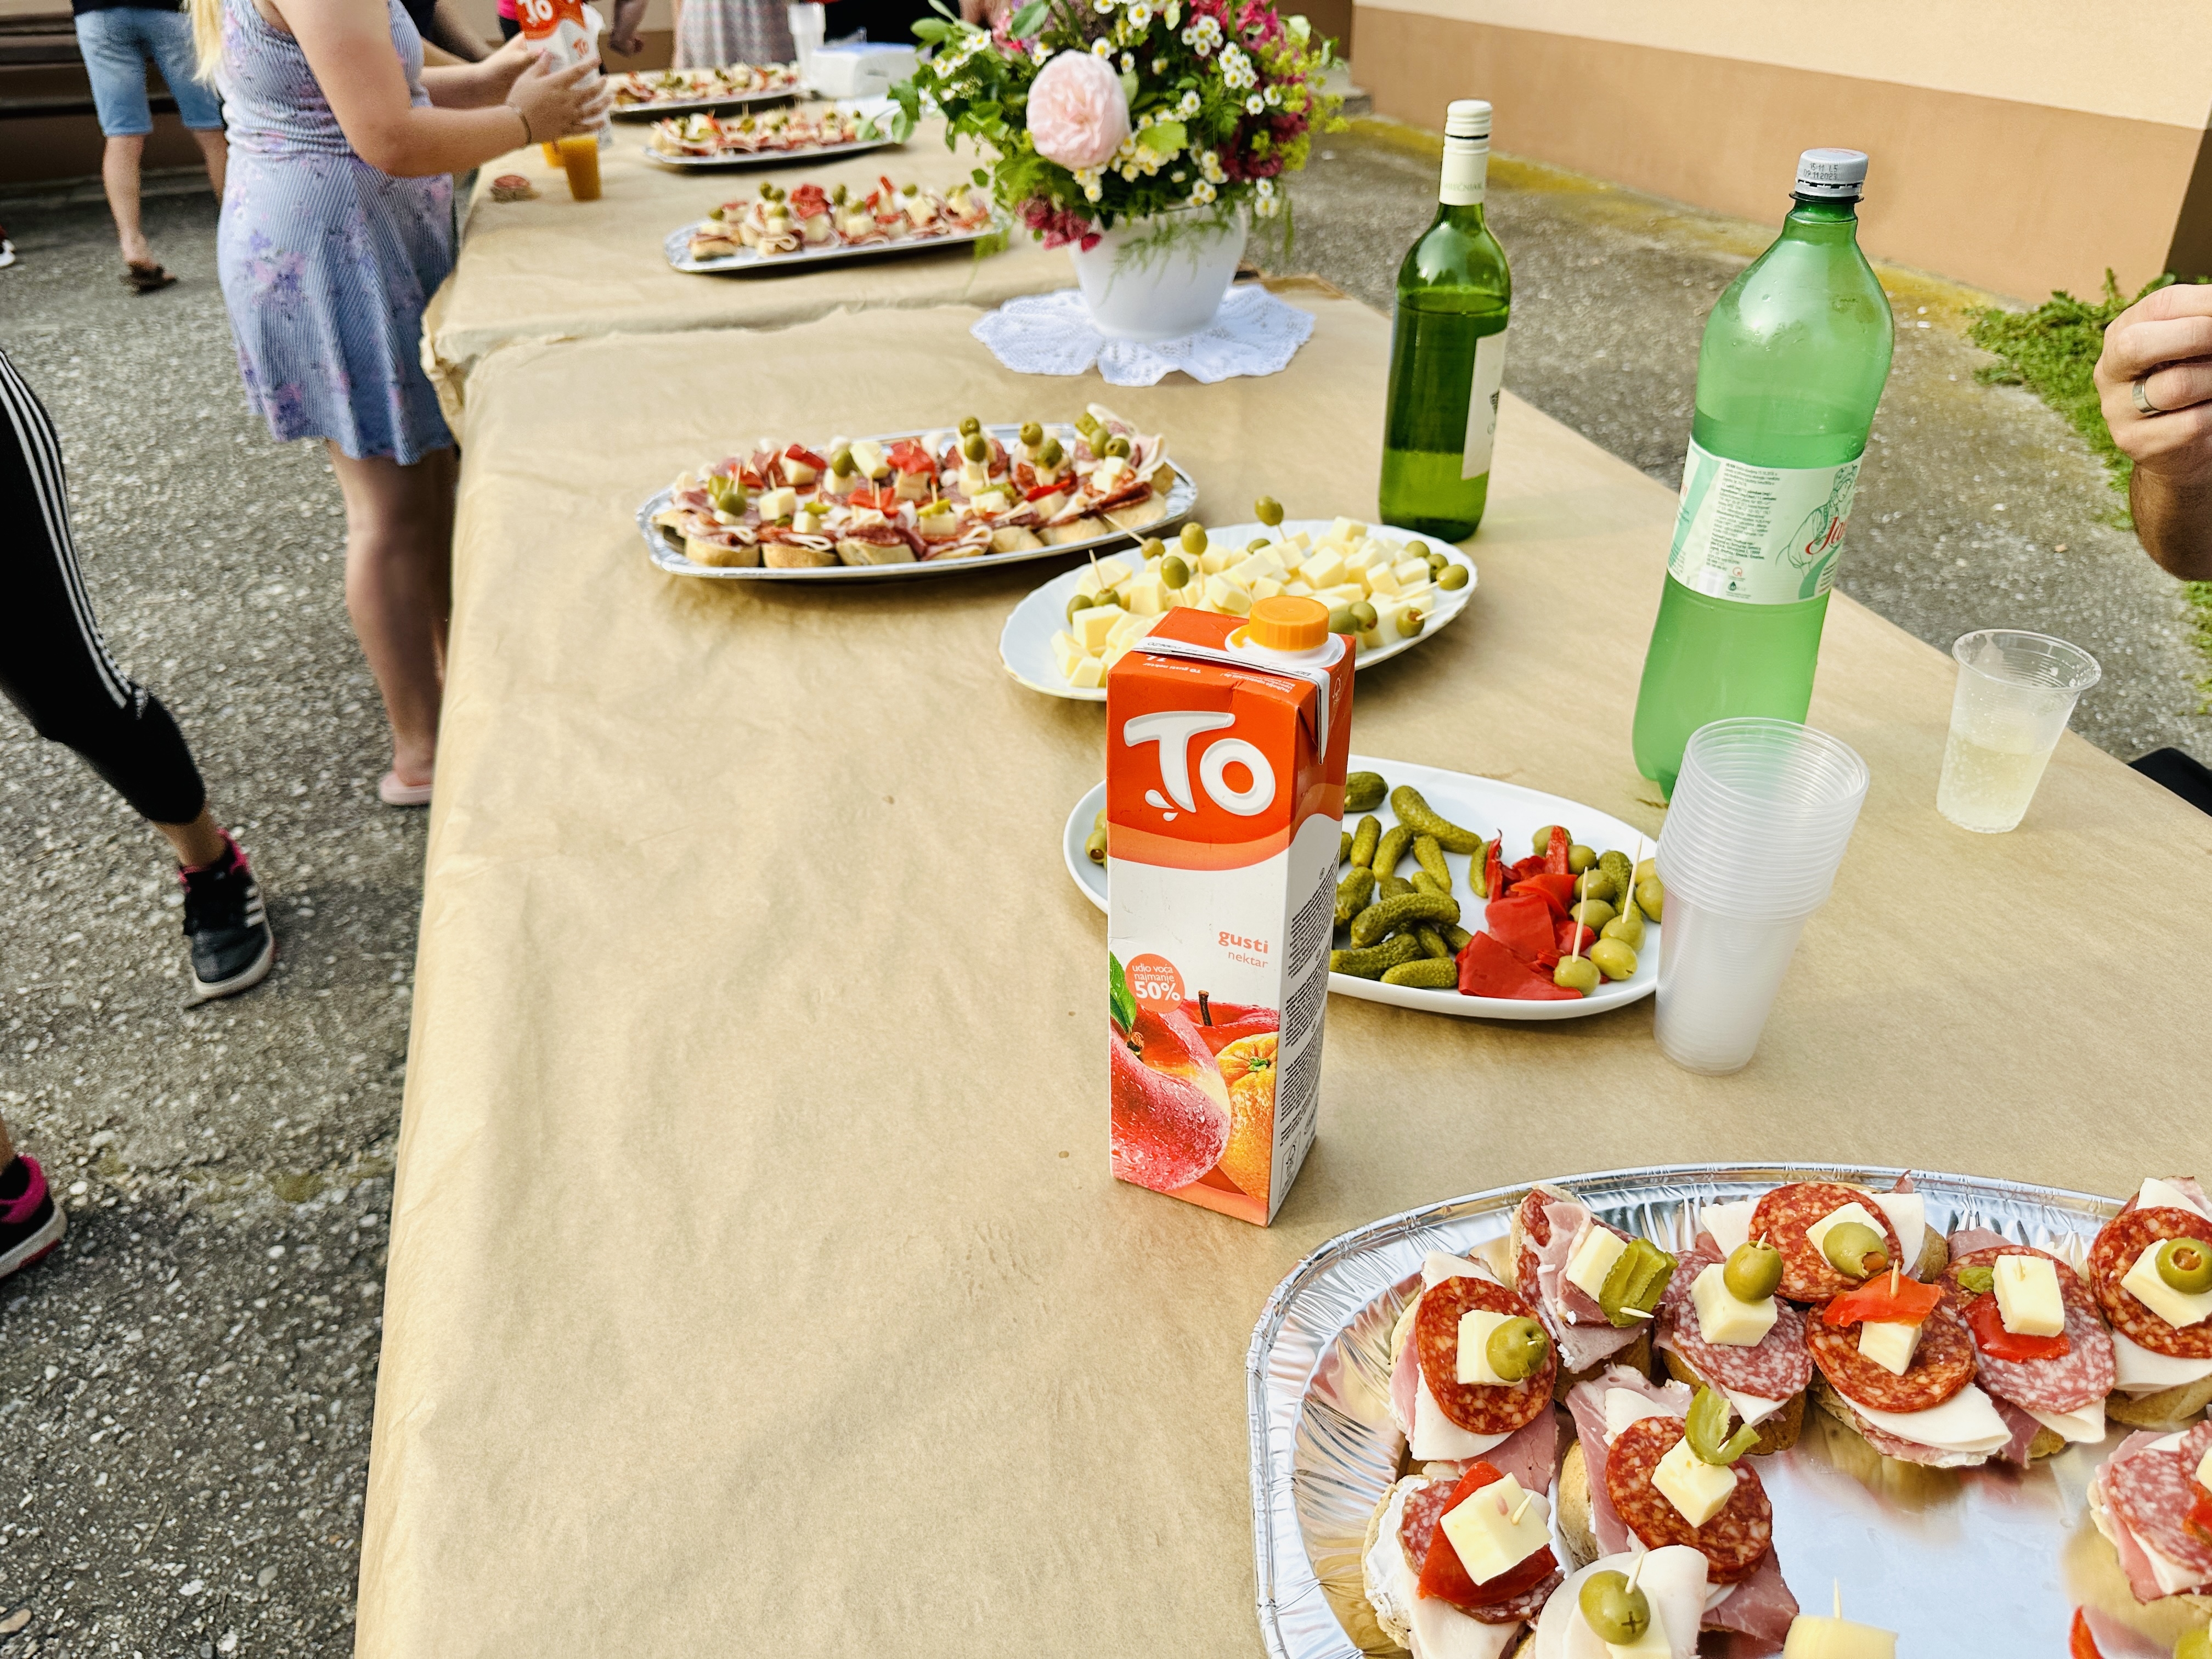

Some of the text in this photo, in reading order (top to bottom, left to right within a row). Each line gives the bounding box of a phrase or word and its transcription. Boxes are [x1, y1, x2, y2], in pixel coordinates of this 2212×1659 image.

[1218, 931, 1268, 953] gusti
[1132, 963, 1174, 973] udio voća
[1228, 951, 1268, 968] nektar
[1134, 972, 1175, 983] najmanje
[1134, 980, 1181, 1001] 50%
